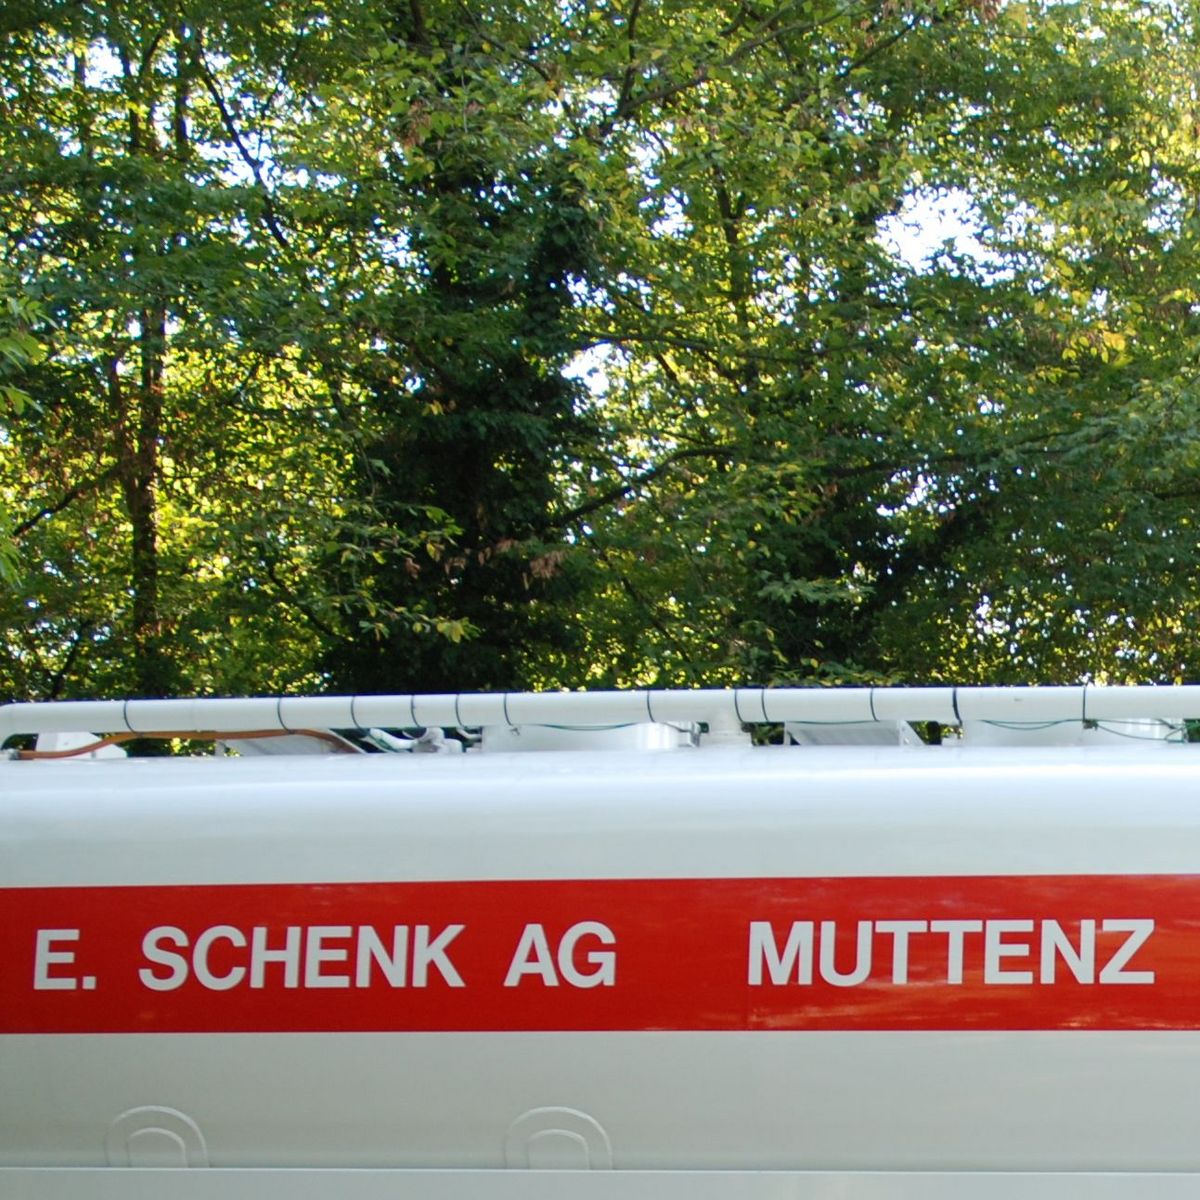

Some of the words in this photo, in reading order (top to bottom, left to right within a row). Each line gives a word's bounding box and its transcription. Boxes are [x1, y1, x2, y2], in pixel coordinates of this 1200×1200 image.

[34, 929, 96, 990] E.
[138, 924, 465, 991] SCHENK
[503, 921, 617, 987] AG
[748, 918, 1155, 986] MUTTENZ
